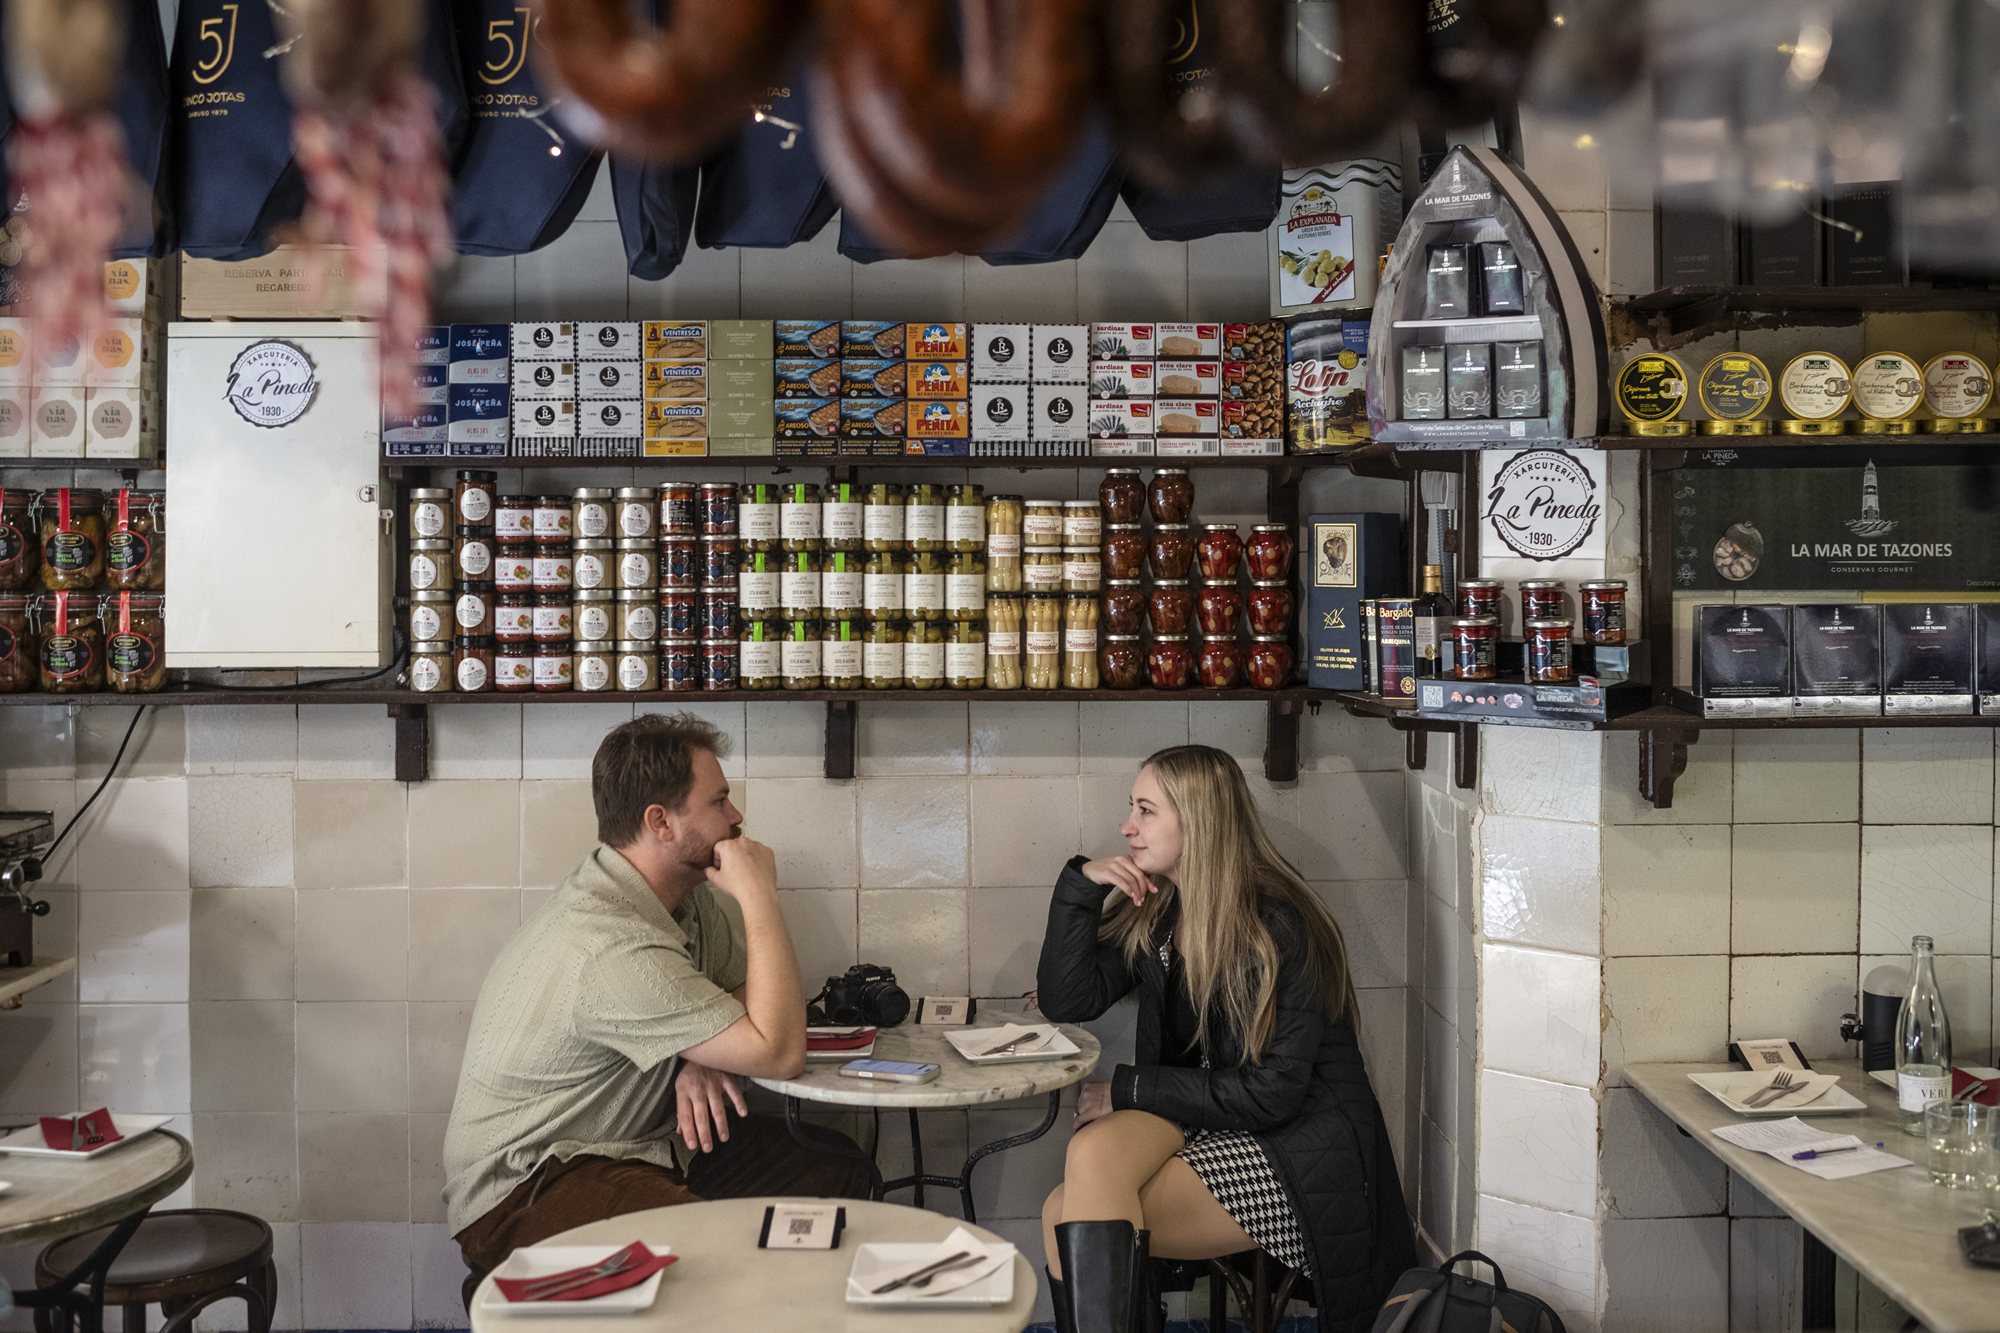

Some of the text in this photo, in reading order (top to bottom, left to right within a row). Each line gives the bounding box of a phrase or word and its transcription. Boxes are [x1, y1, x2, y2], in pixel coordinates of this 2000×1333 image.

[192, 4, 239, 84] 5J
[478, 7, 531, 85] 5J
[206, 92, 246, 103] JOTAS
[496, 94, 539, 105] JOTAS
[1425, 192, 1491, 206] LA MAR DE TAZONES
[1289, 215, 1338, 230] LA EXPLANADA
[223, 268, 273, 278] RESERVA
[664, 329, 701, 337] VENTRESCA
[455, 338, 503, 347] JOSÉ PEÑA
[915, 340, 959, 352] PEÑITA
[247, 351, 299, 367] XARCUTERIA
[665, 368, 701, 377] VENTRESCA
[221, 369, 317, 407] La Pineda
[915, 380, 960, 392] PEÑITA
[1789, 381, 1824, 389] Berberechos
[1860, 381, 1895, 389] Berberechos
[455, 398, 502, 407] JOSÉ PEÑA
[1294, 397, 1344, 410] Acciughe
[665, 407, 701, 416] VENTRESCA
[916, 418, 961, 431] PEÑITA
[1513, 462, 1577, 484] XARCUTERIA
[1480, 484, 1602, 531] La Pineda
[1529, 531, 1553, 546] 1930
[1791, 543, 1952, 557] LA MAR DE TAZONES
[1966, 579, 1995, 587] Descubre
[1379, 606, 1413, 620] Bargalló
[1536, 694, 1574, 703] LA PINEDA
